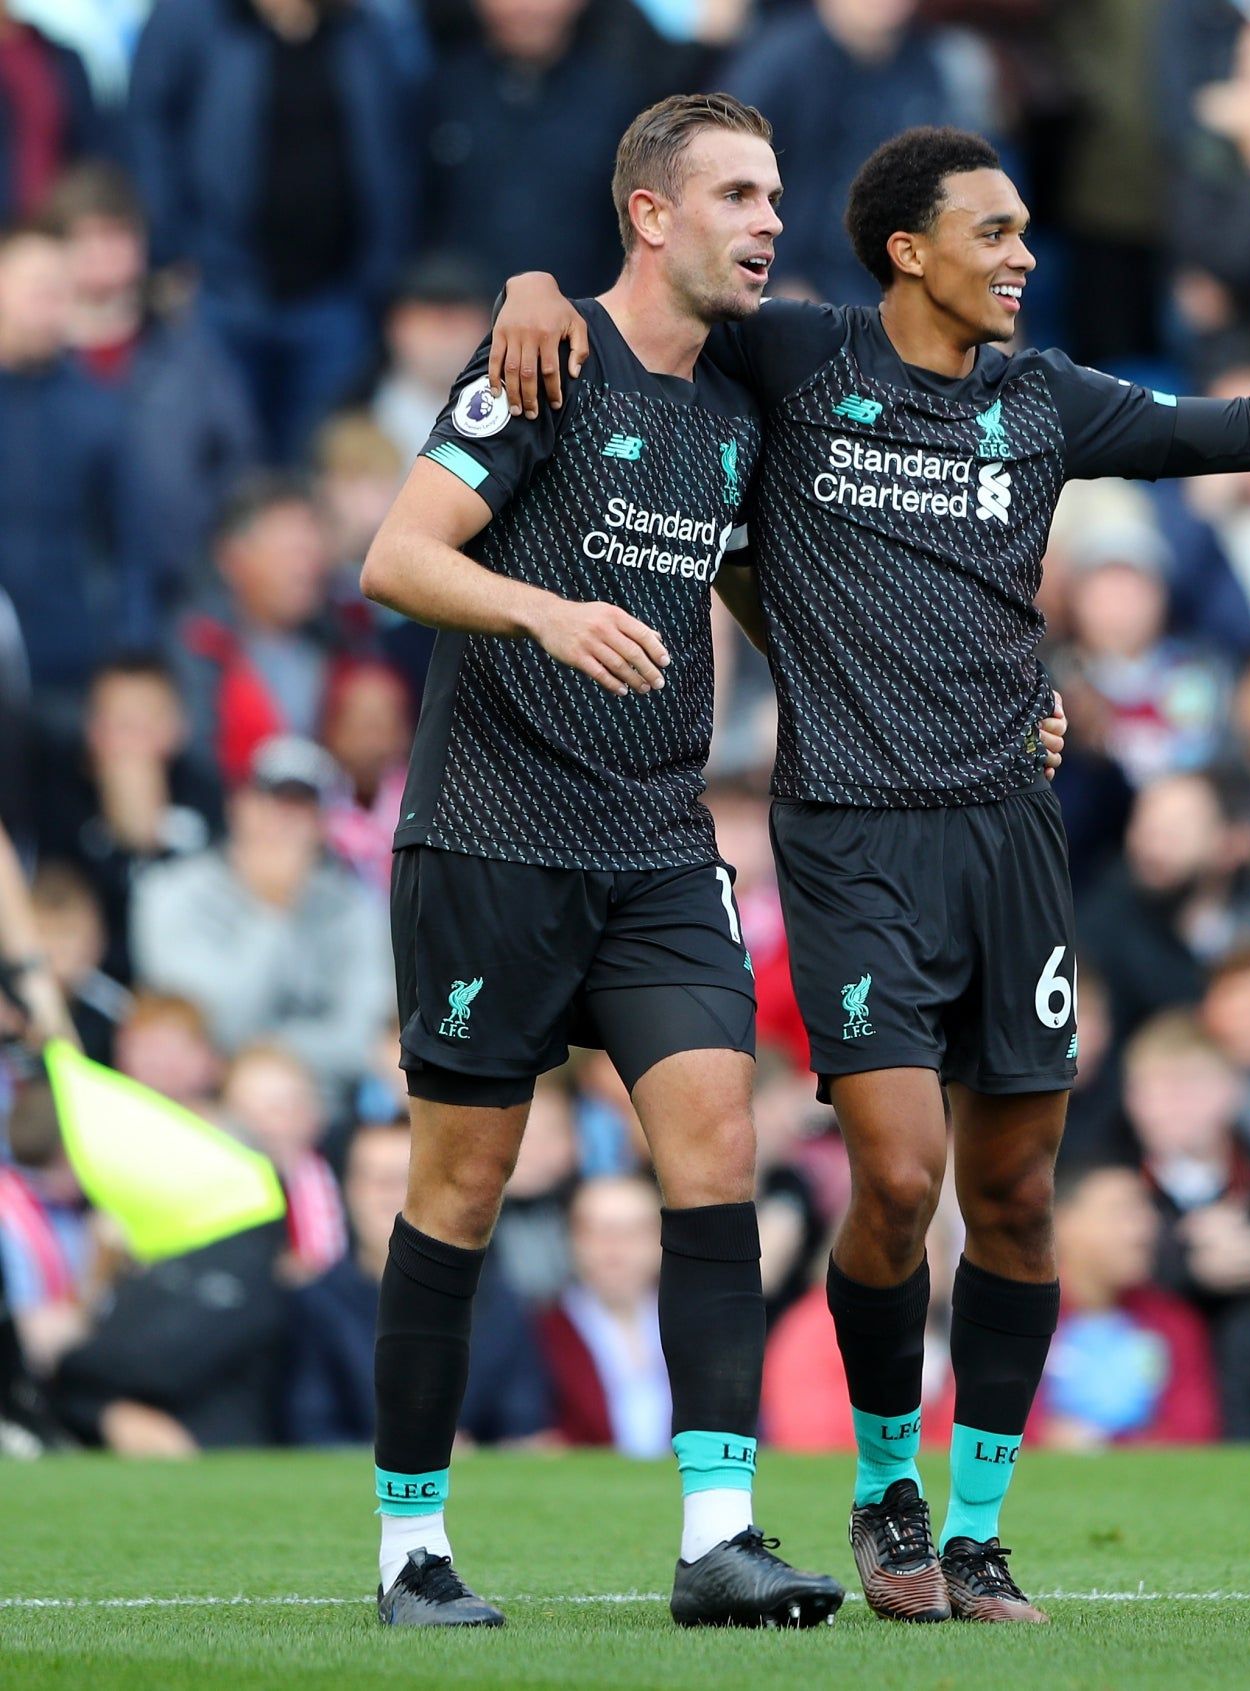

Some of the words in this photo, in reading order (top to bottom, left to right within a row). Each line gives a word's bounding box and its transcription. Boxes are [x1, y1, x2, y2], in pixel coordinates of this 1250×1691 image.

[829, 438, 973, 483] Standard
[813, 472, 968, 518] Chartered
[604, 497, 716, 546] Standard
[582, 530, 712, 582] Chartered
